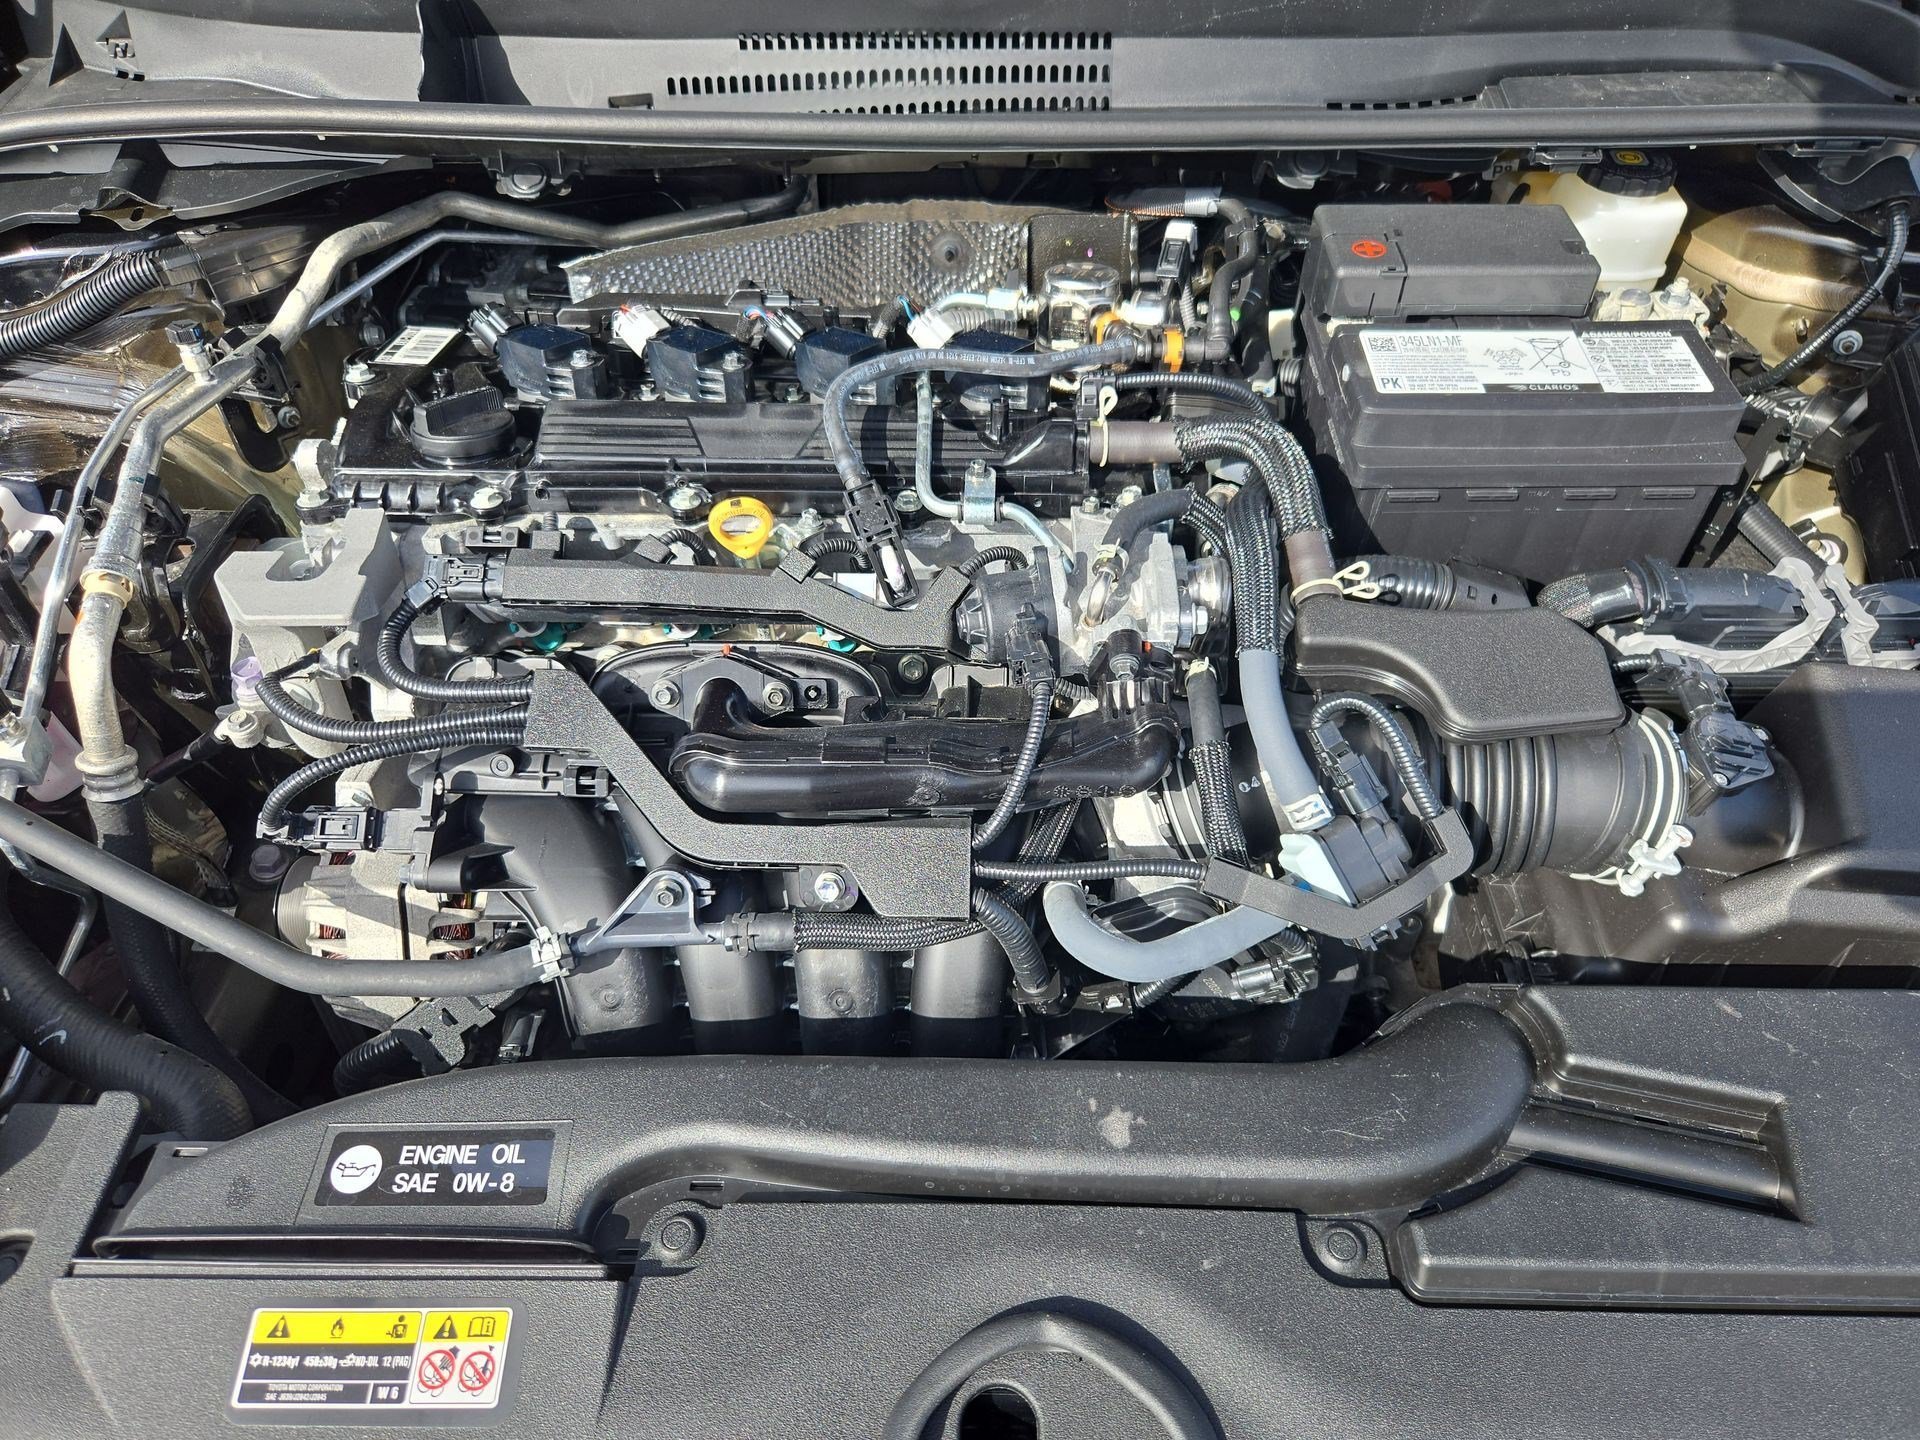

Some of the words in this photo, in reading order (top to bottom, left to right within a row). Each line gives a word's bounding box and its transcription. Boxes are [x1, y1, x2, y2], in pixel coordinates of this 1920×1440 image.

[1398, 335, 1463, 347] 345LN1-MF
[1380, 377, 1402, 389] PK
[399, 1145, 479, 1165] ENGINE
[491, 1144, 525, 1164] OIL
[391, 1173, 439, 1193] SAE
[452, 1172, 515, 1193] 0W-8
[377, 1386, 391, 1399] W
[391, 1386, 400, 1399] 6
